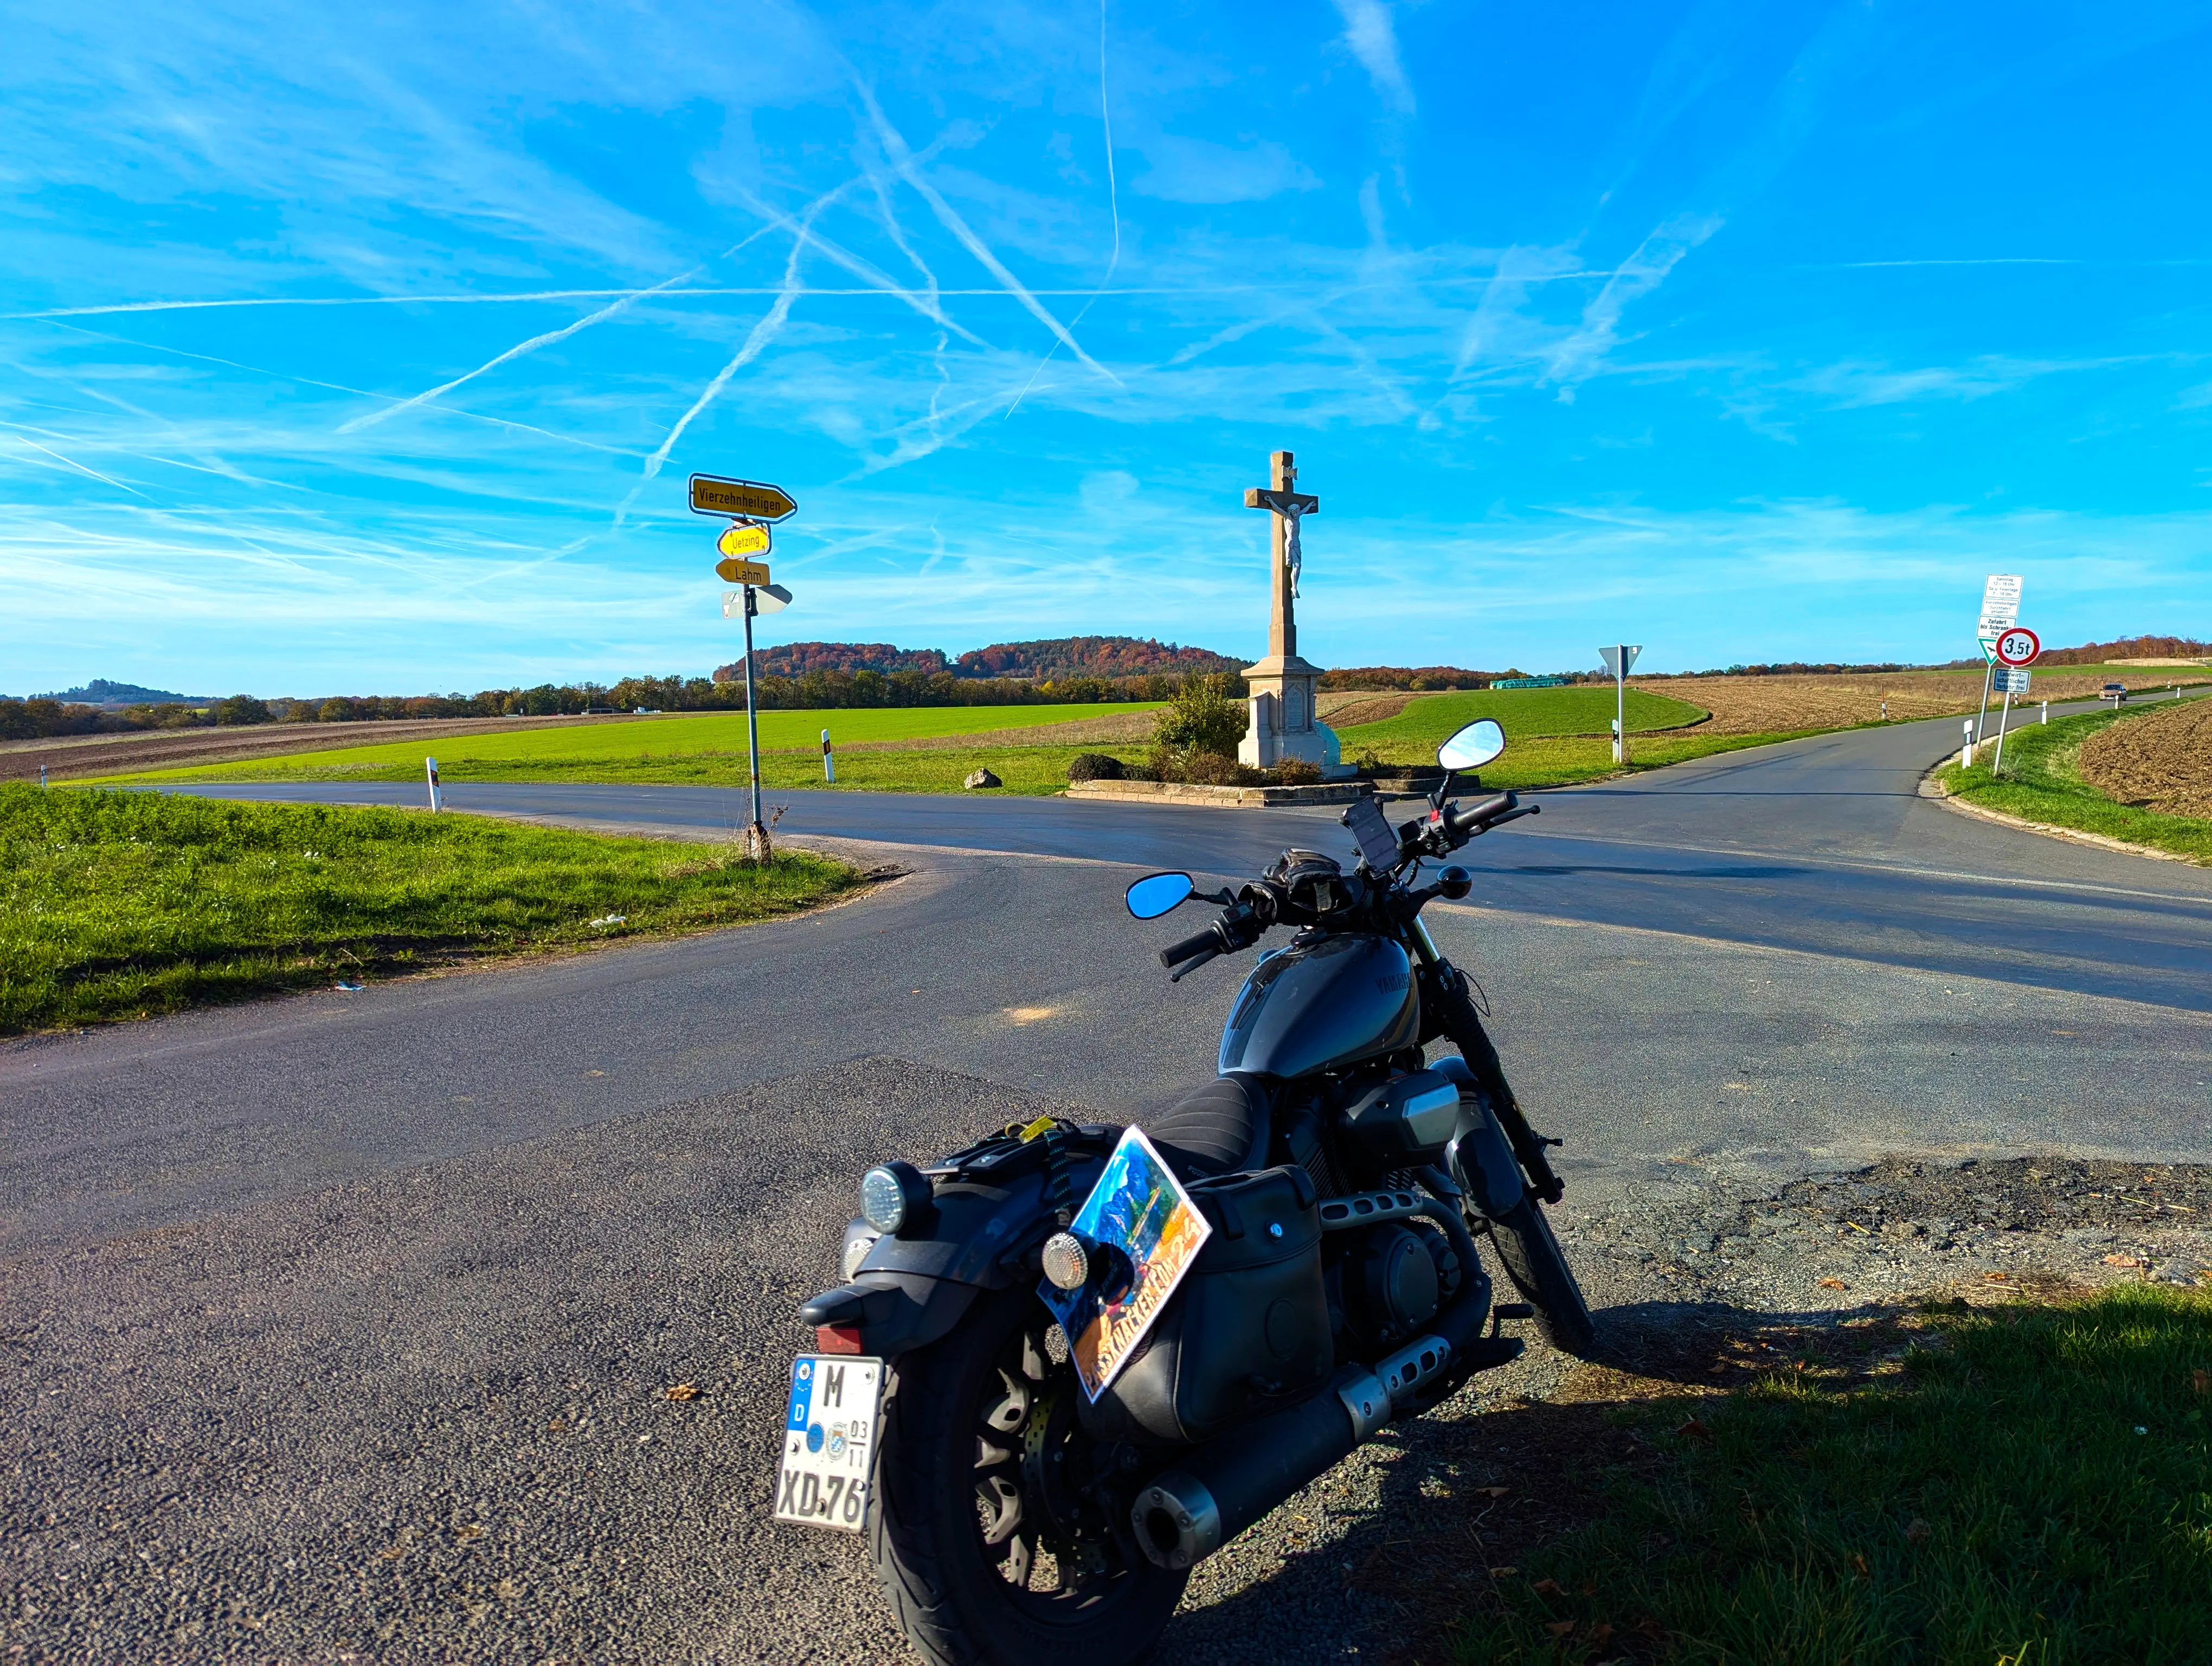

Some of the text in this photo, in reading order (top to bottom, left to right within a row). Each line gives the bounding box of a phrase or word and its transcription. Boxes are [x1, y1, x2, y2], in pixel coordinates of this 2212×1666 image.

[699, 487, 781, 512] Vierzehnheiligen
[732, 535, 760, 549] Uetzing
[735, 567, 762, 582] Lahm
[1168, 1216, 1202, 1266] 24
[823, 1364, 845, 1407] M
[794, 1404, 805, 1422] D
[850, 1420, 867, 1438] 03
[849, 1449, 863, 1468] 11
[779, 1469, 861, 1523] XD 76
